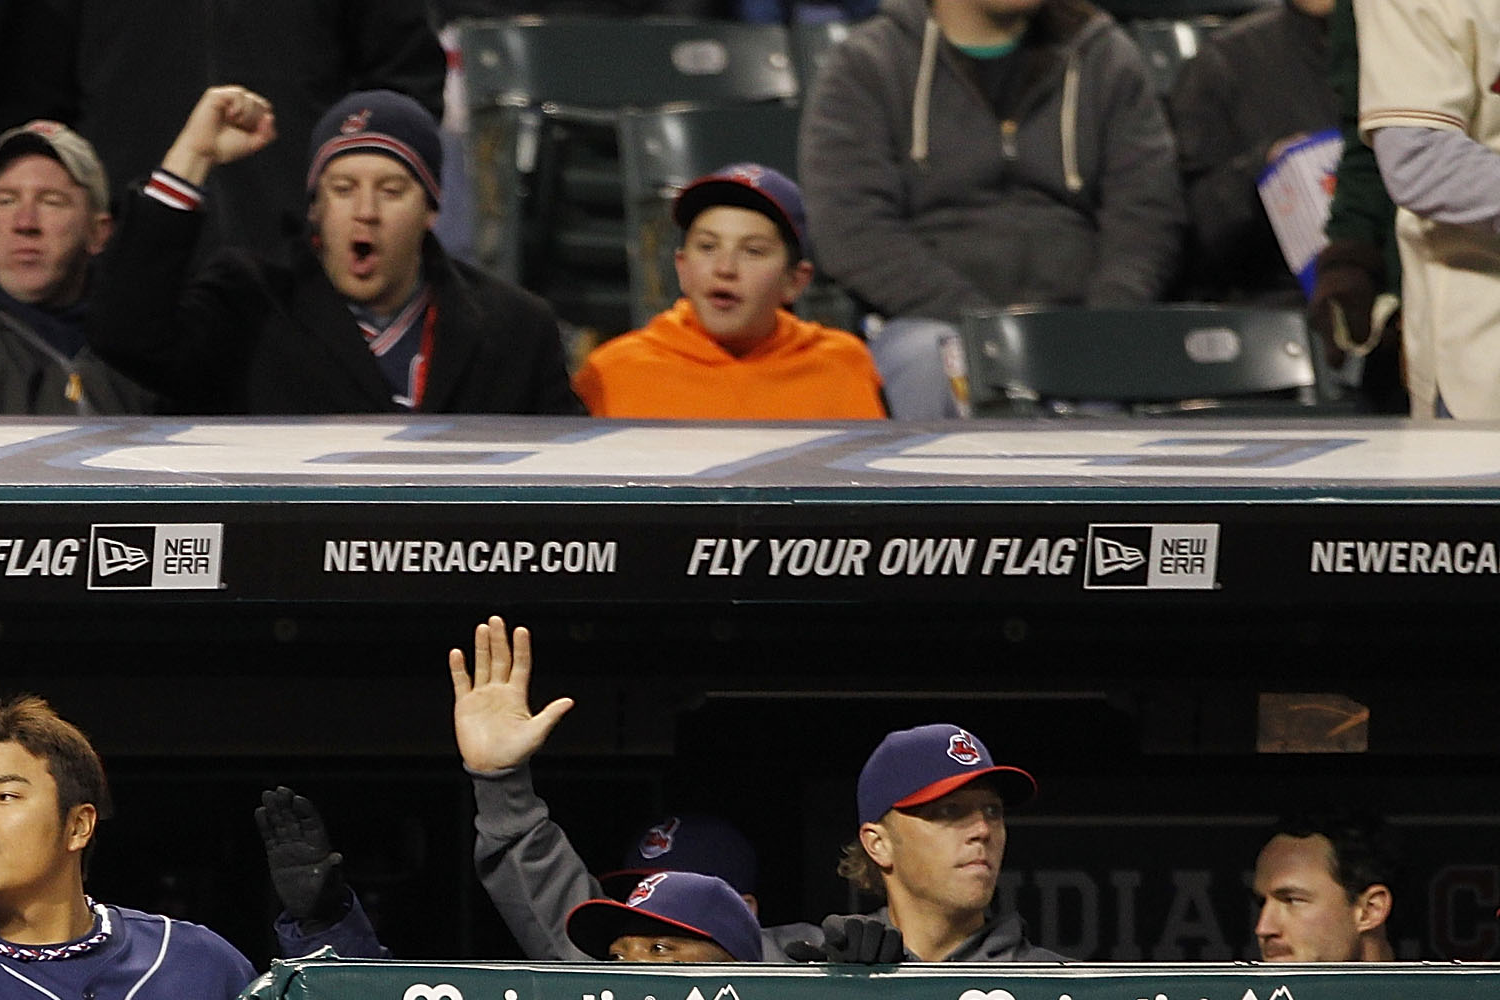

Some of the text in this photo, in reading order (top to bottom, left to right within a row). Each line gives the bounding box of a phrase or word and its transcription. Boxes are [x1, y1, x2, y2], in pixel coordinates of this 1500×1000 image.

[165, 539, 210, 555] NEW
[1161, 539, 1207, 555] NEW
[324, 541, 617, 572] NEWERACAP.COM
[687, 538, 1077, 576] FLY YOUR OWN FLAG
[1311, 541, 1500, 573] NEWERACA
[164, 557, 209, 574] ERA
[1160, 557, 1205, 574] ERA
